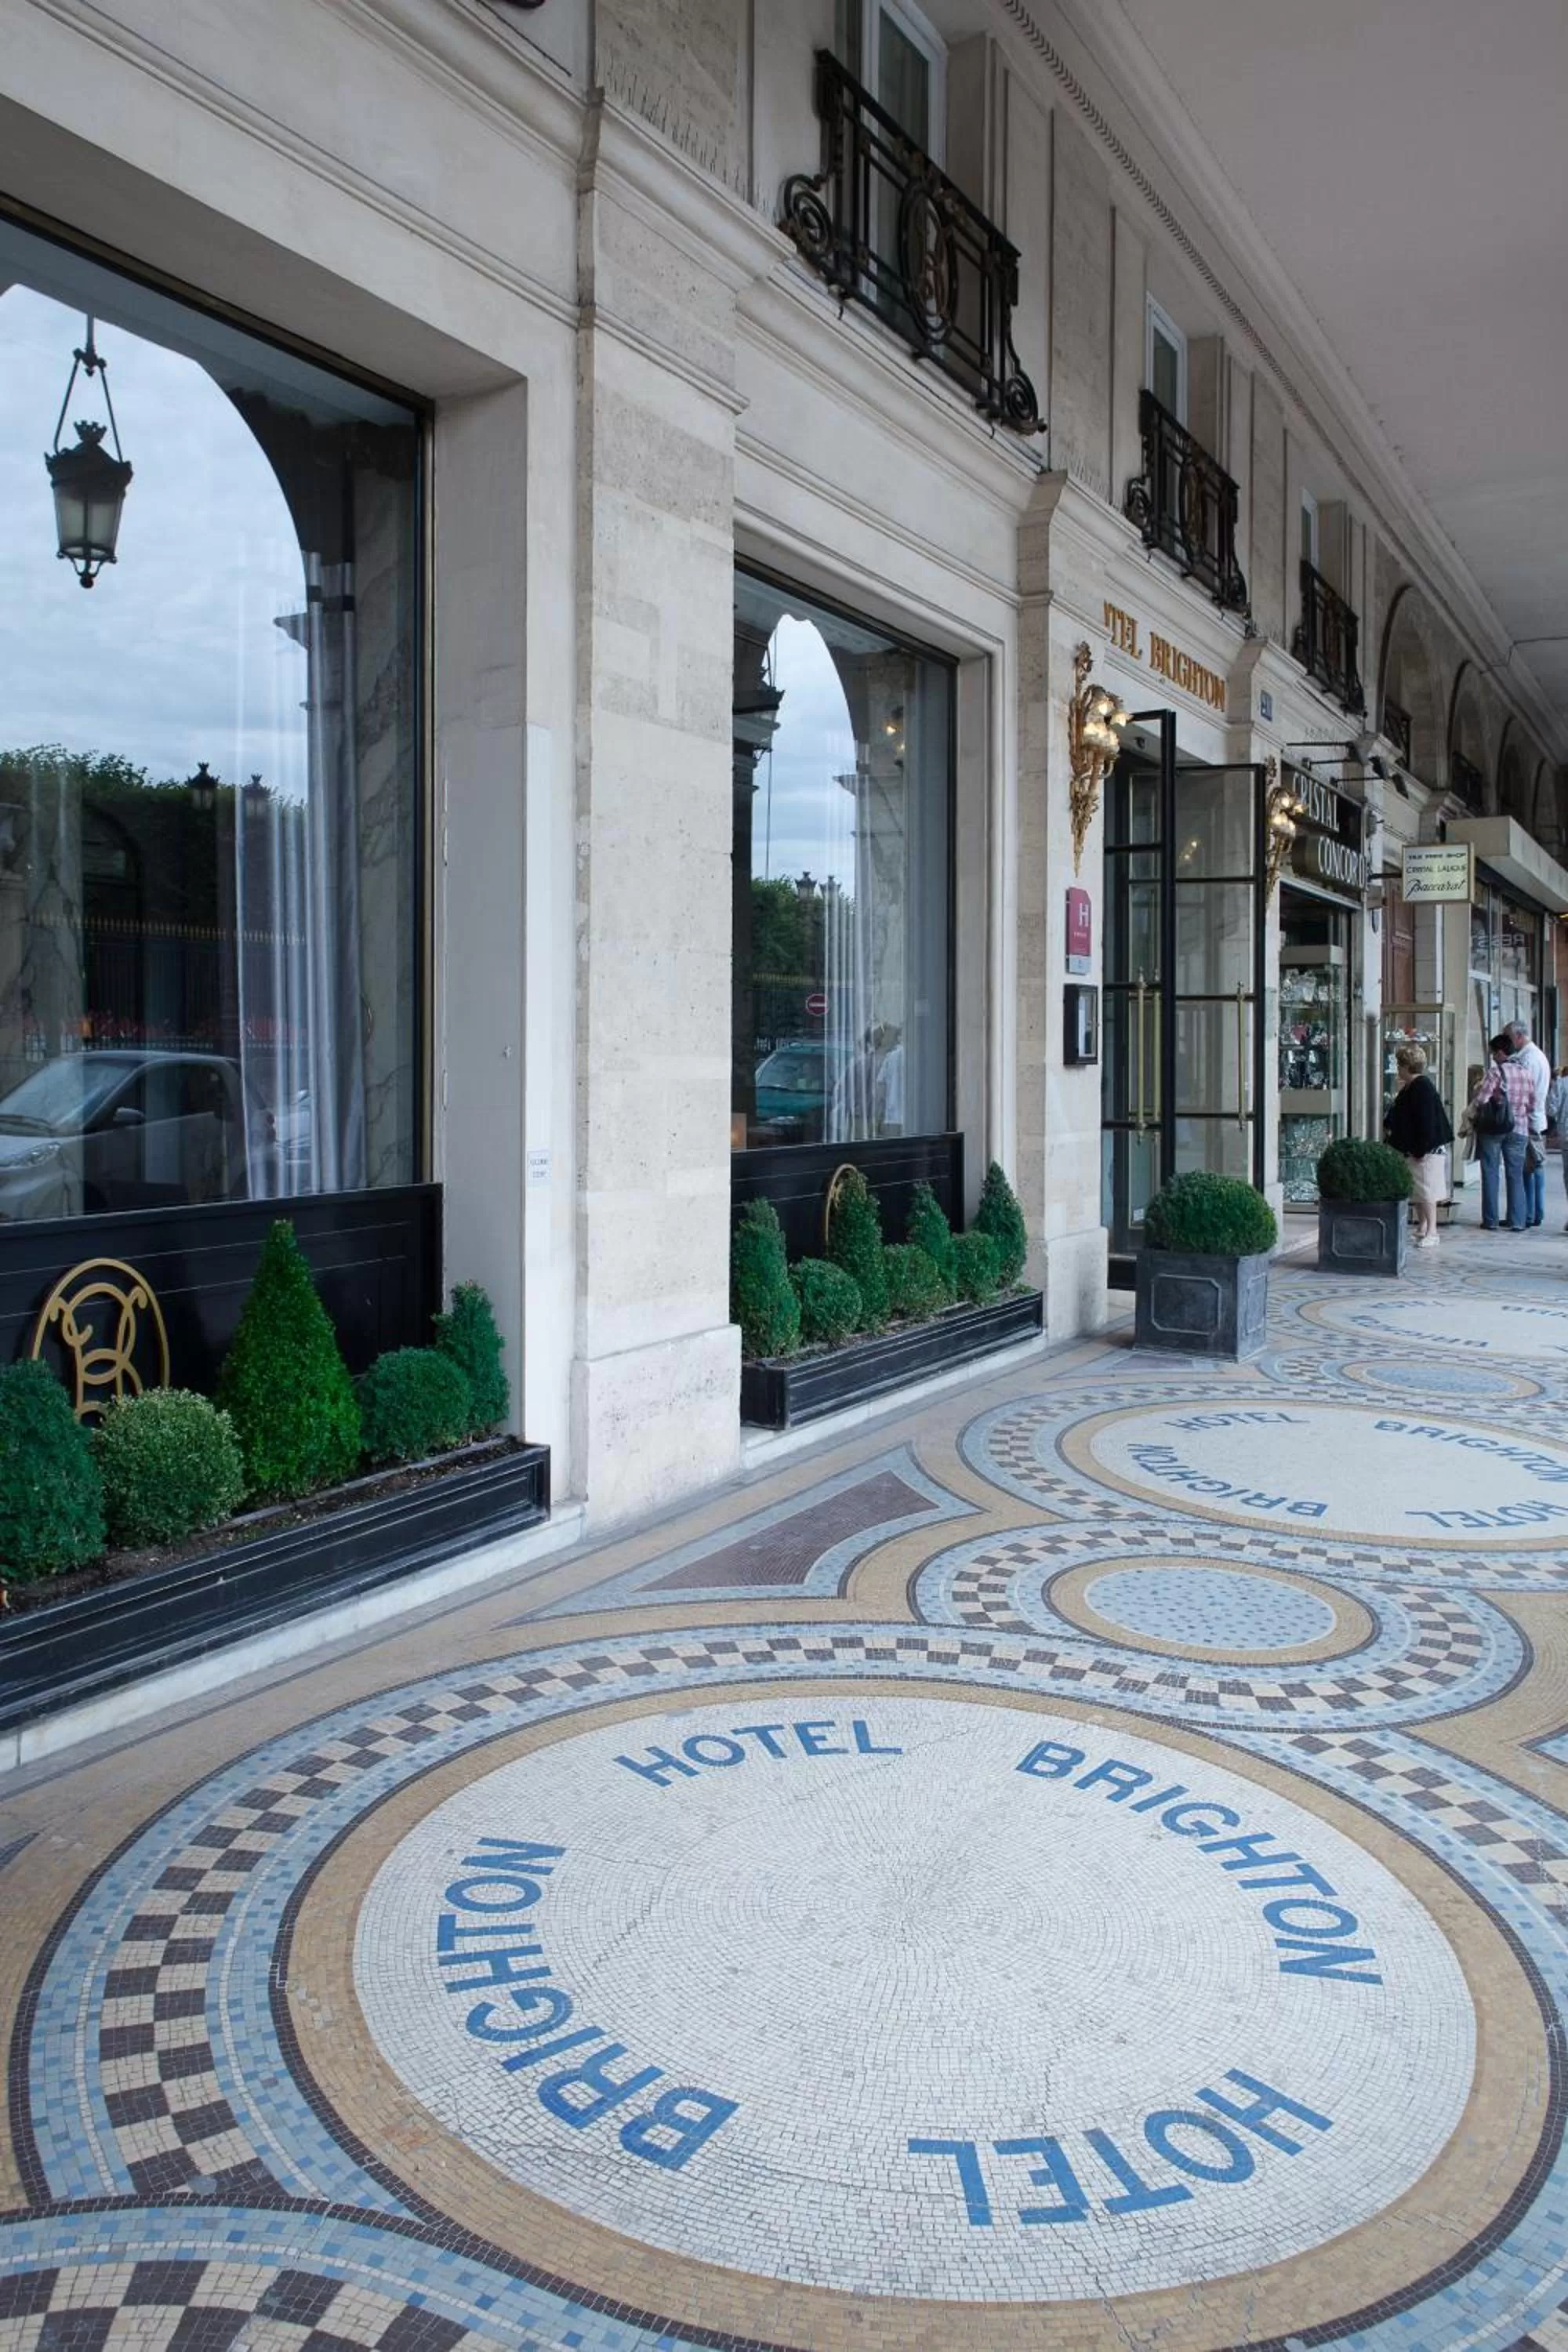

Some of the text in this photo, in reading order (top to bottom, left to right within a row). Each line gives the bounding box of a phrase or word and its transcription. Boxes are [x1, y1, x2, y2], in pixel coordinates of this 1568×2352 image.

[1149, 631, 1225, 713] BRIGHTON
[1294, 771, 1340, 833] CRISTAL
[1079, 902, 1089, 927] H
[1404, 879, 1466, 899] Baccarat
[1163, 1412, 1311, 1432] HOTEL
[1127, 1443, 1568, 1528] HOTEL BRIGHTON
[612, 1720, 1383, 1984] HOTEL BRIGHTON
[437, 1836, 1334, 2226] HOTEL BRIGHTON
